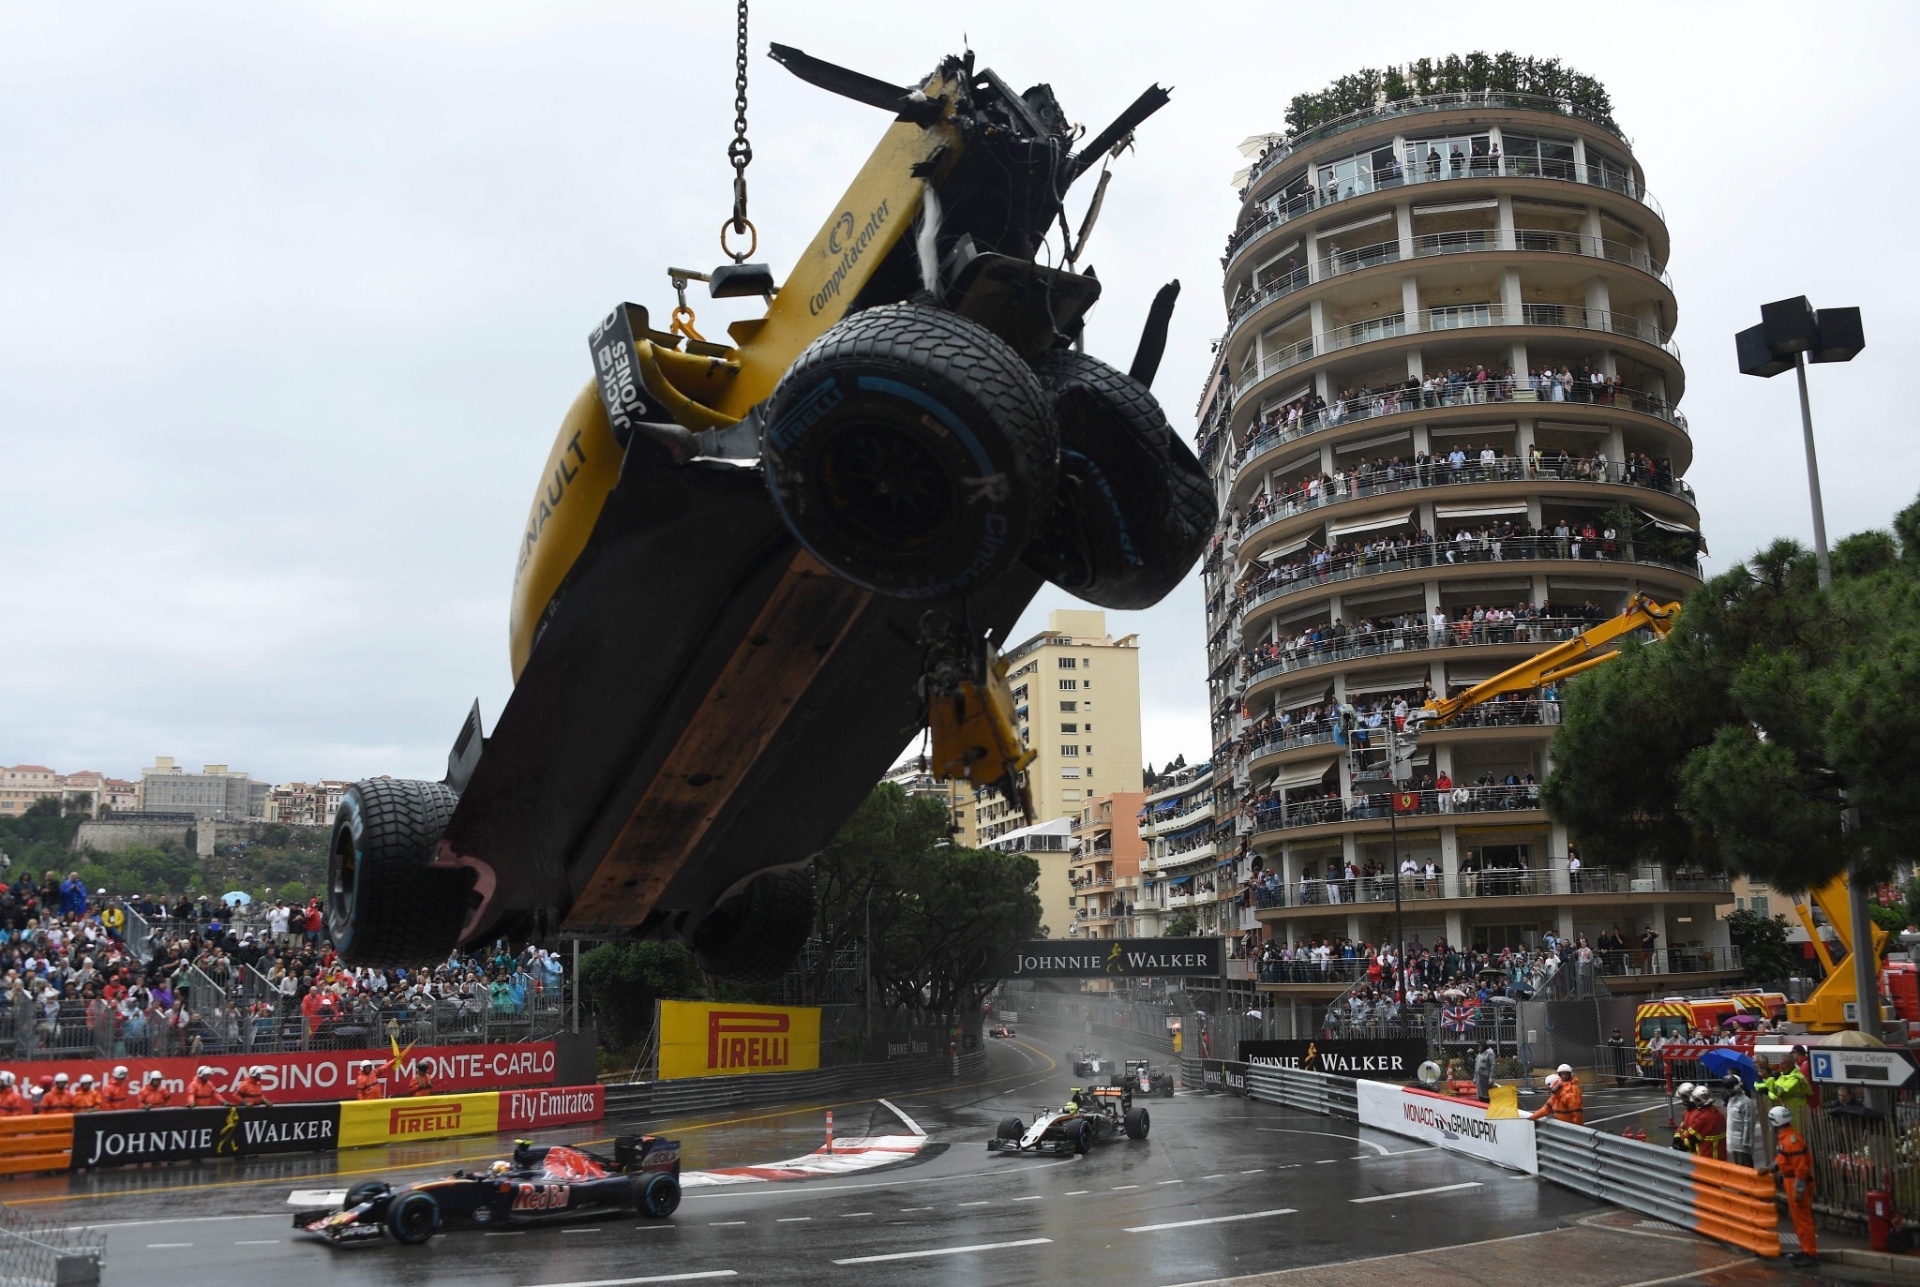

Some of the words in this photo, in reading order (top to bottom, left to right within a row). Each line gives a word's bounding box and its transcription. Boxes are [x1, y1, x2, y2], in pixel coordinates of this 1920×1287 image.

[809, 198, 889, 316] Computacenter
[612, 340, 647, 415] JONES
[603, 369, 632, 429] JACK
[769, 376, 846, 450] PIRELLI
[1014, 954, 1100, 974] JOHNNIE
[1127, 952, 1208, 968] WALKER
[707, 1011, 790, 1069] PIRELLI
[395, 1050, 555, 1083] MONTE-CARLO
[1320, 1053, 1404, 1071] WALKER
[1838, 1053, 1864, 1063] Sainte
[1865, 1053, 1894, 1064] Dévote
[1225, 1070, 1244, 1088] WALKER
[389, 1103, 462, 1135] PIRELLI
[511, 1093, 537, 1122] Fly
[540, 1089, 594, 1116] Emirates
[1403, 1102, 1435, 1127] MONACO
[88, 1128, 213, 1164] JOHNNIE
[244, 1120, 333, 1144] WALKER
[512, 1183, 548, 1210] Red
[549, 1185, 570, 1208] Bull
